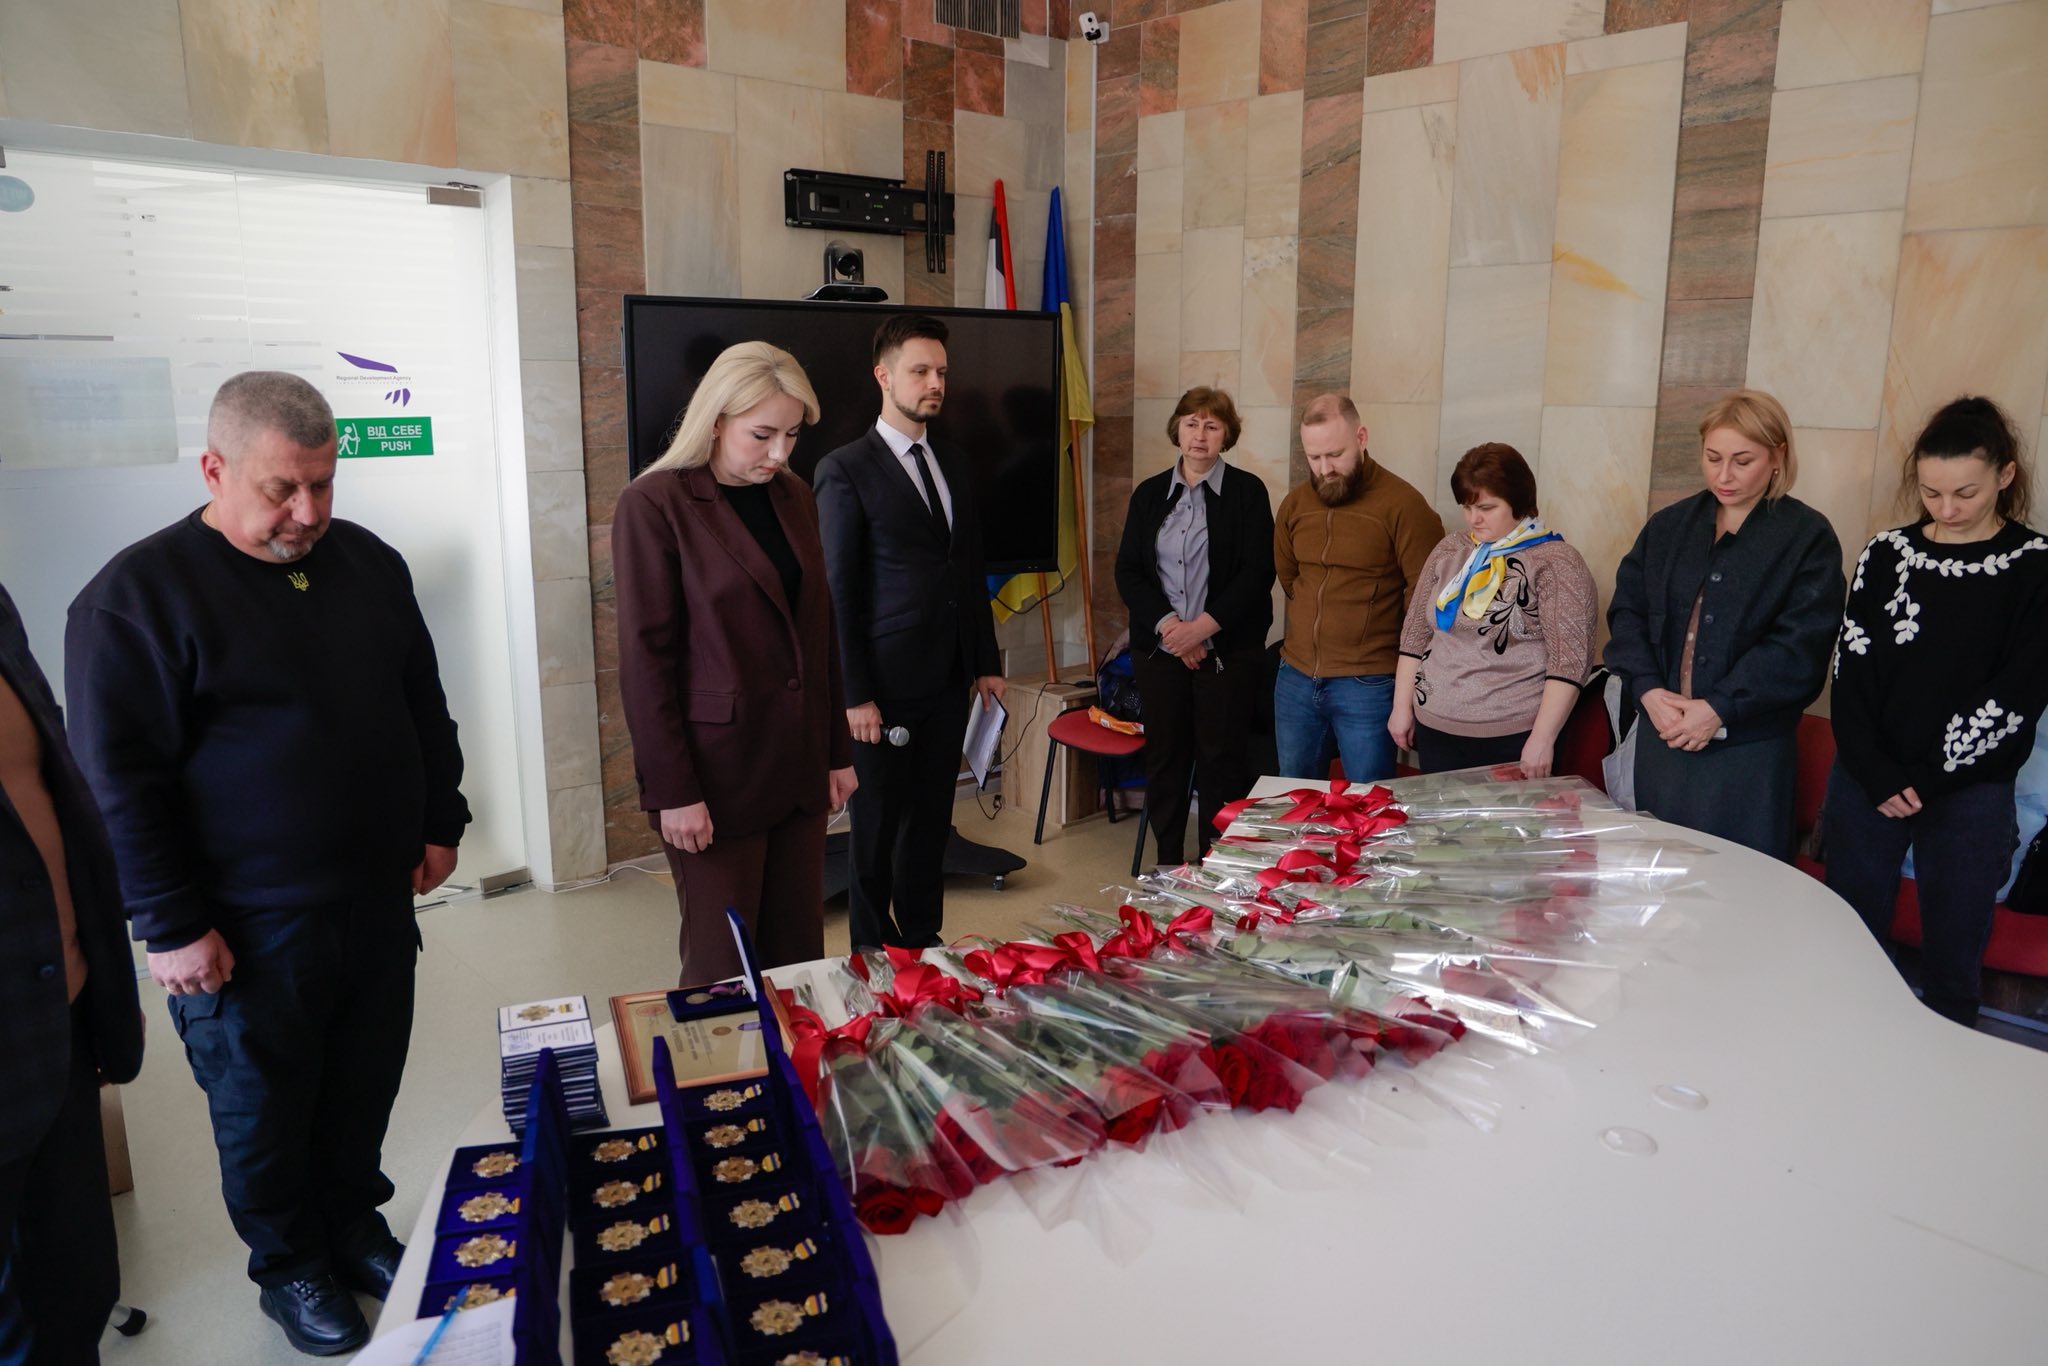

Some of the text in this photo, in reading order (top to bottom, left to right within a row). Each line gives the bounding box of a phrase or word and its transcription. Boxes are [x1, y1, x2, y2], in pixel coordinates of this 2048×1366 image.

[367, 425, 422, 437] ВІД СЕБЕ
[381, 441, 411, 452] PUSH
